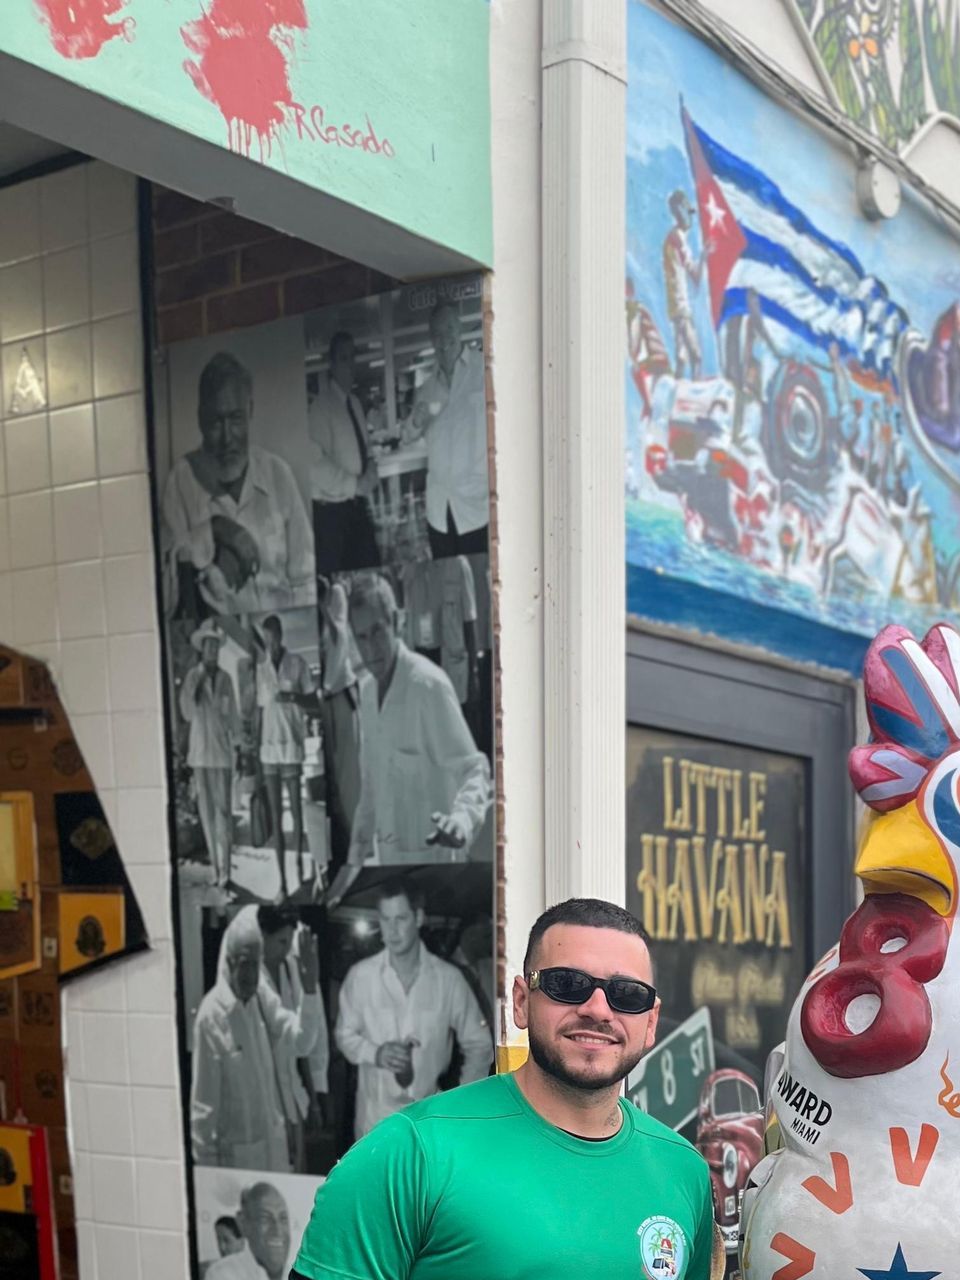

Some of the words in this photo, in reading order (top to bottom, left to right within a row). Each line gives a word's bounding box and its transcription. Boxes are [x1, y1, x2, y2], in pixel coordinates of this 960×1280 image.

[663, 756, 767, 840] LITTLE
[637, 833, 792, 948] HAVANA
[660, 1049, 676, 1105] 8
[690, 1037, 706, 1077] ST
[777, 1071, 833, 1126] AWARD
[790, 1117, 821, 1145] MIAMI
